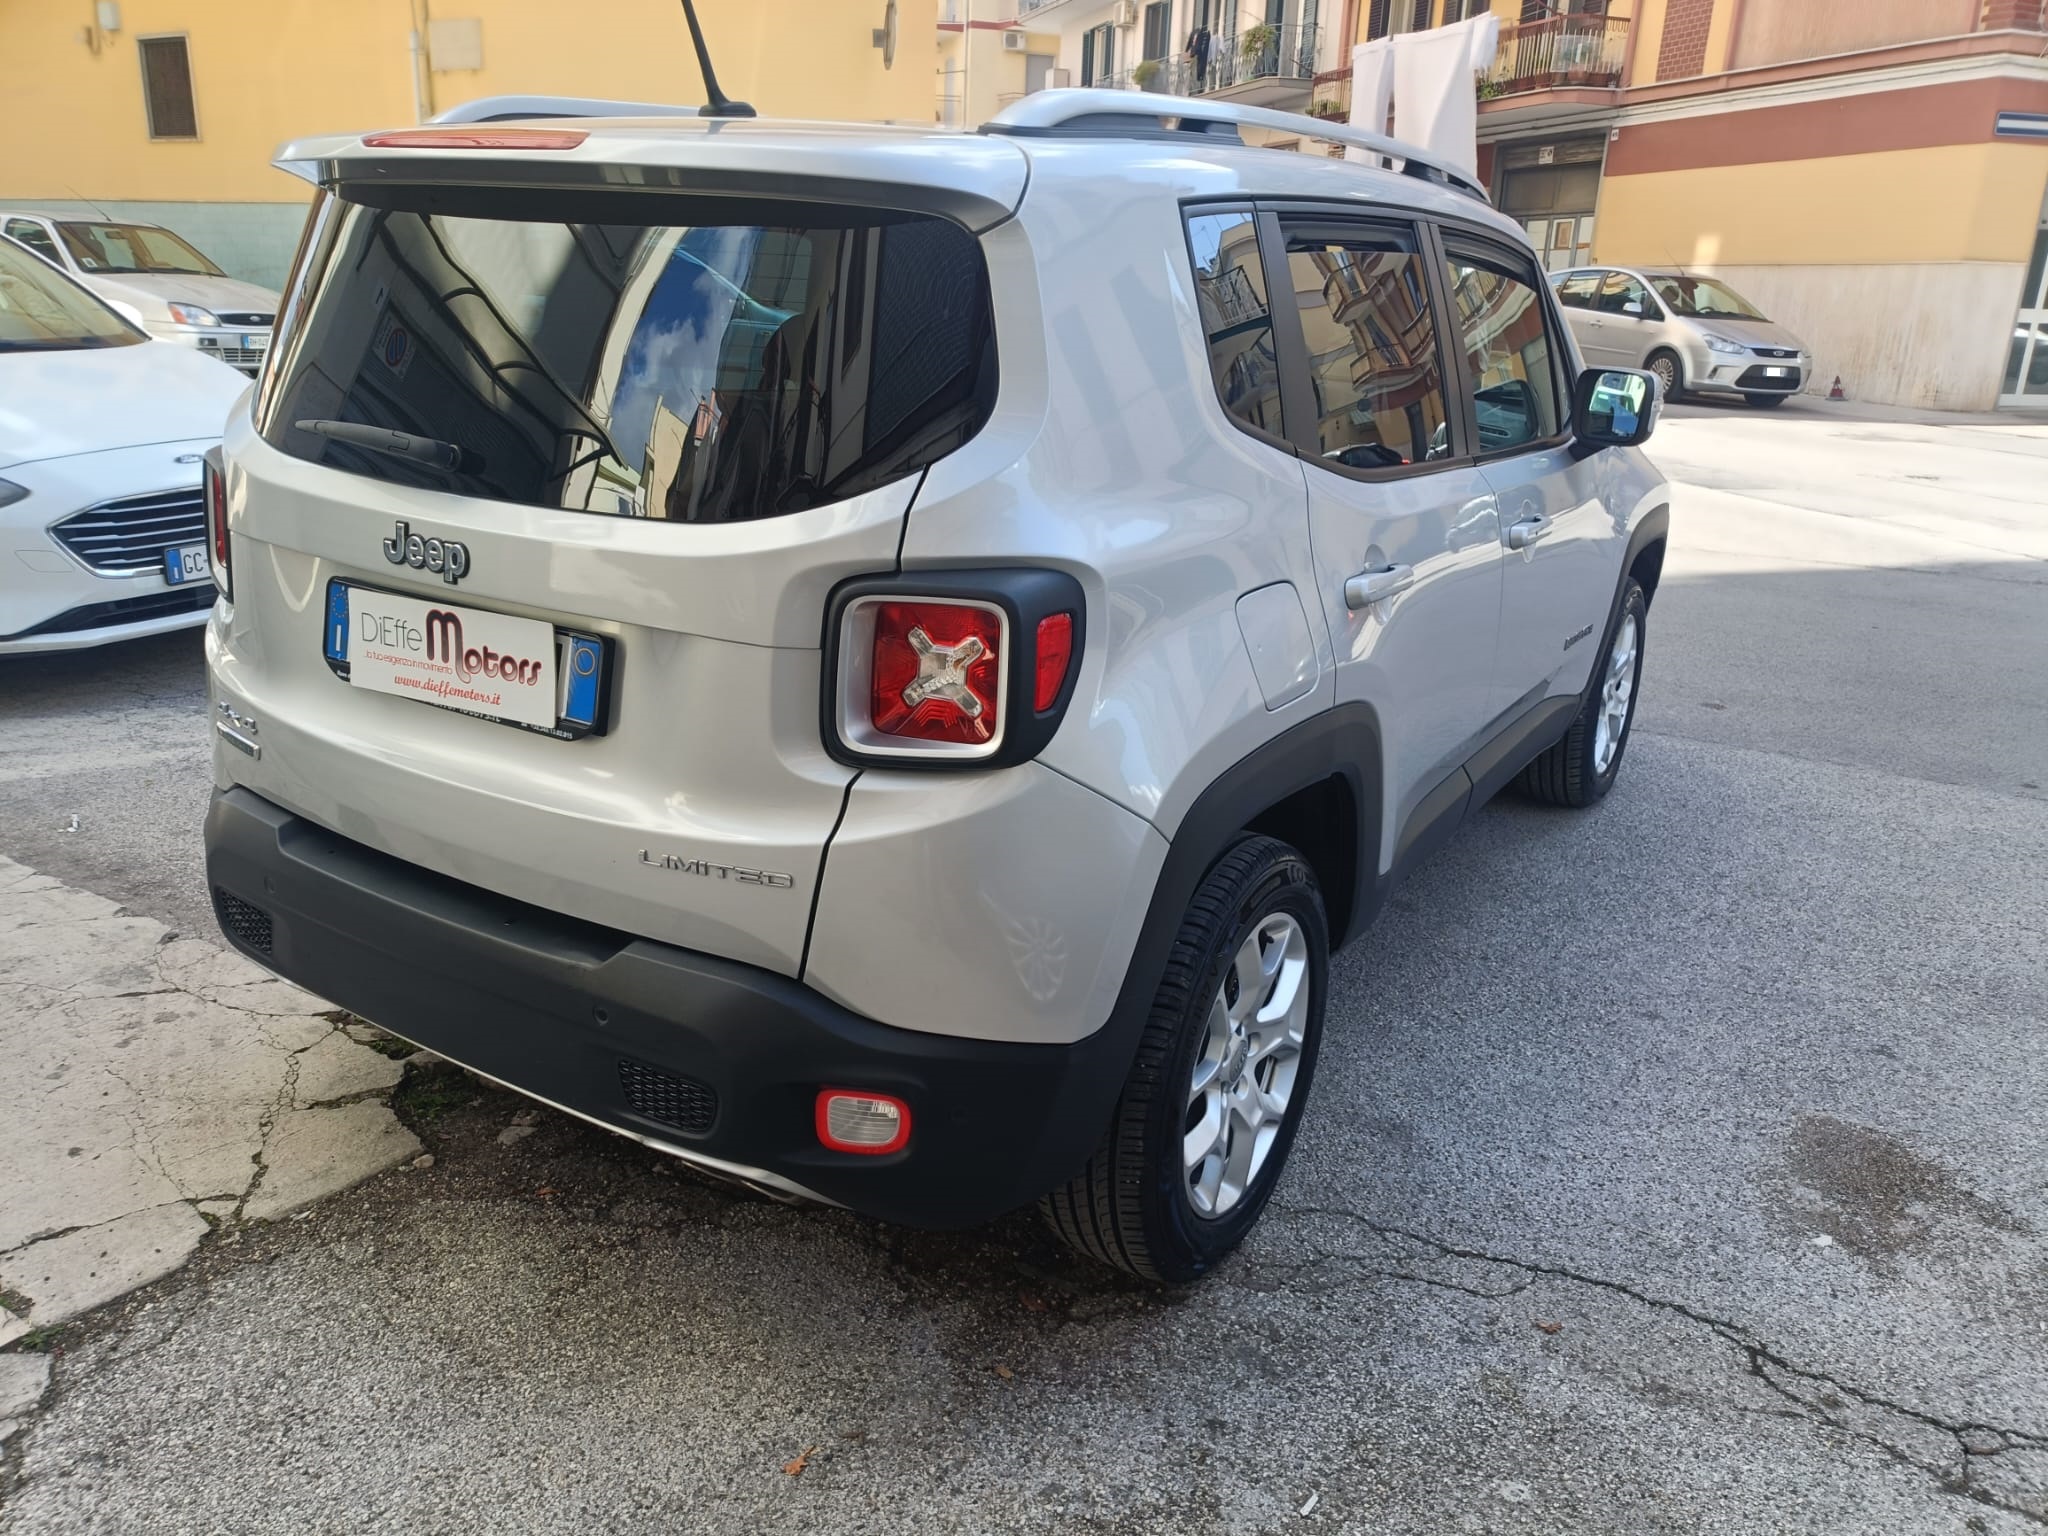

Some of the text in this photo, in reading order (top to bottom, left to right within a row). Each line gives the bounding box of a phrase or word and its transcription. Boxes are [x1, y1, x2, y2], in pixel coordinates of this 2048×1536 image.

[383, 520, 471, 585] Jeep
[361, 608, 542, 687] DiEffe Motors
[394, 673, 502, 706] www.dieffemotors.it
[638, 849, 793, 889] LIMITED
